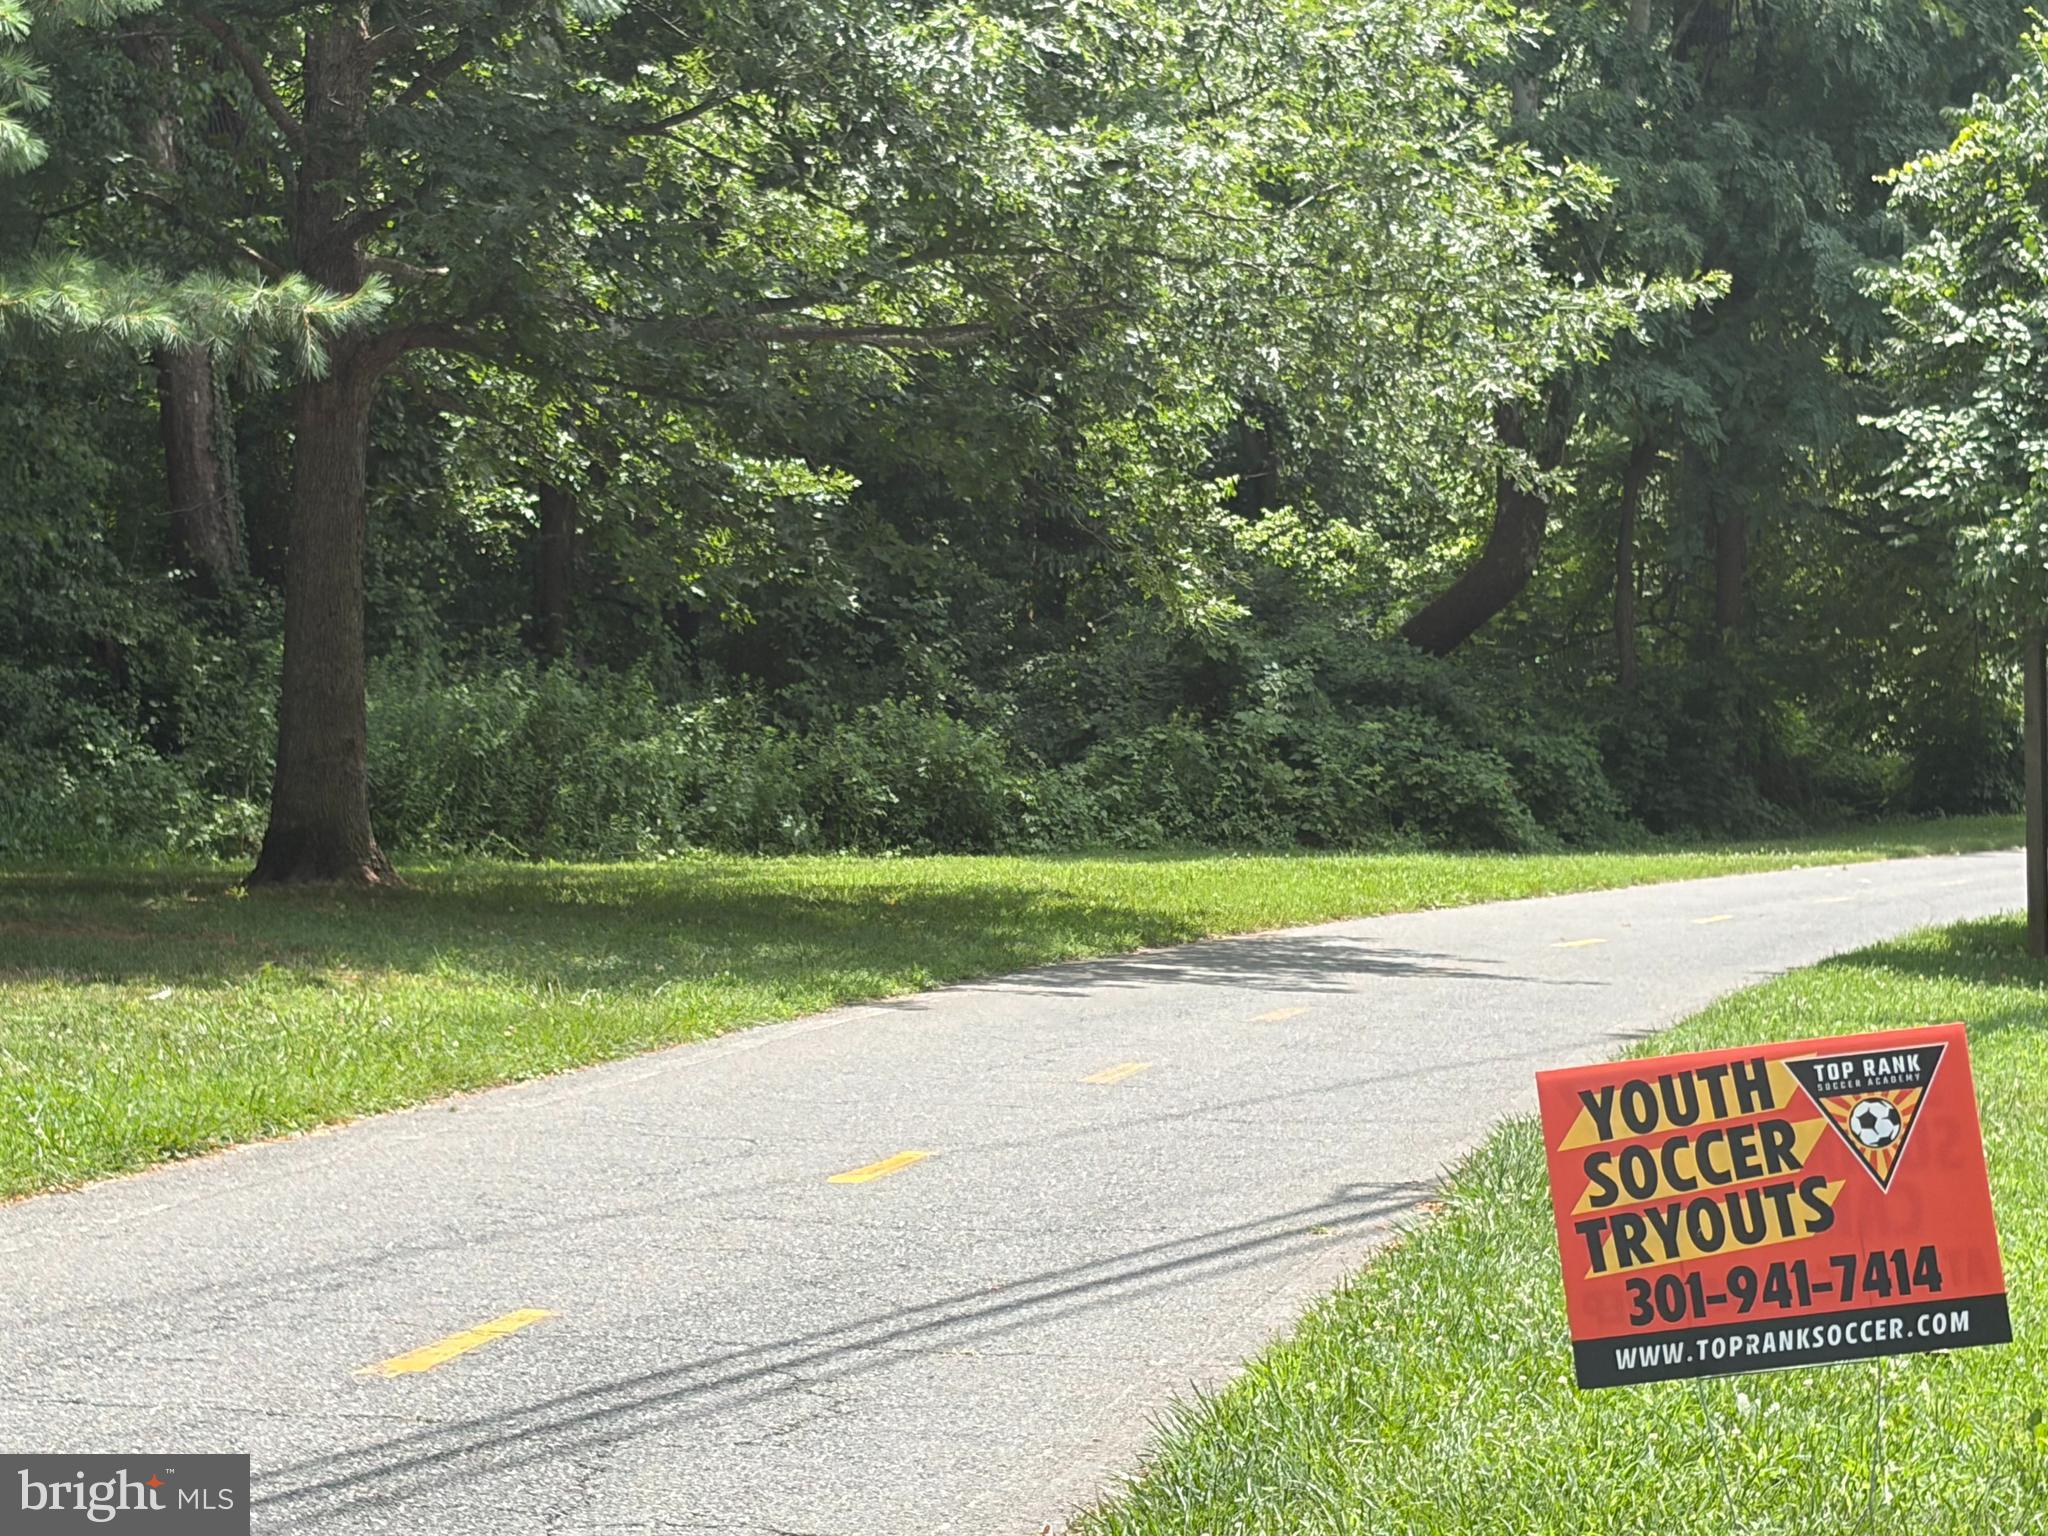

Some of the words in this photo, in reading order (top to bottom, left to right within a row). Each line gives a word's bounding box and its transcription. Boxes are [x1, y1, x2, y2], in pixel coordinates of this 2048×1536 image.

[1578, 1057, 1774, 1141] YOUTH
[1813, 1062, 1854, 1082] TOP
[1862, 1054, 1921, 1077] RANK
[1817, 1079, 1862, 1092] SOCCER
[1867, 1073, 1921, 1087] ACADEMY
[1583, 1119, 1803, 1208] SOCCER
[1575, 1176, 1835, 1274] TRYOUTS
[1625, 1245, 1942, 1326] 301-941-7414
[1615, 1310, 1970, 1370] WWW.TOPRANKSOCCER.COM
